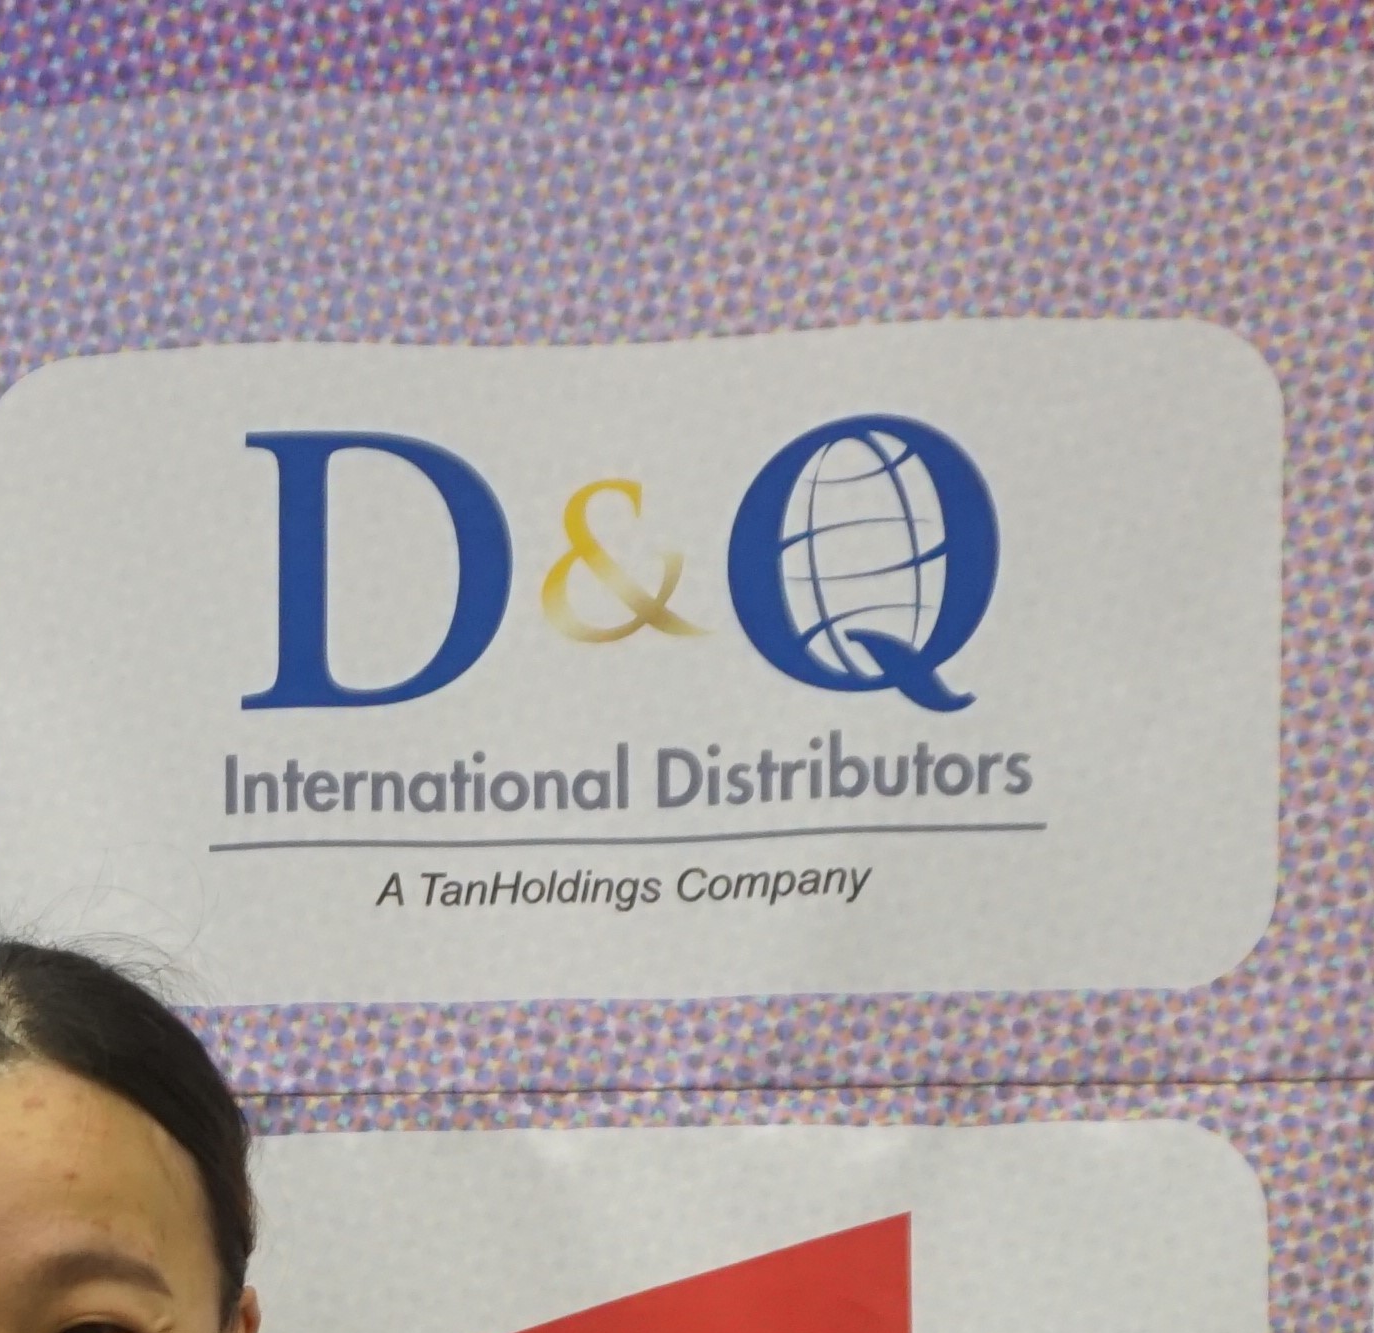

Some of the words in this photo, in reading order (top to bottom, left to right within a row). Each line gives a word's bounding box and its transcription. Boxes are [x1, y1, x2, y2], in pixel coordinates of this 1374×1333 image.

[241, 431, 513, 710] D
[541, 477, 715, 645] &
[727, 413, 1001, 712] Q
[225, 742, 630, 815] International
[657, 729, 1033, 809] Distributors
[376, 873, 405, 907] A
[419, 868, 662, 911] TanHoldings
[675, 863, 873, 904] Company
